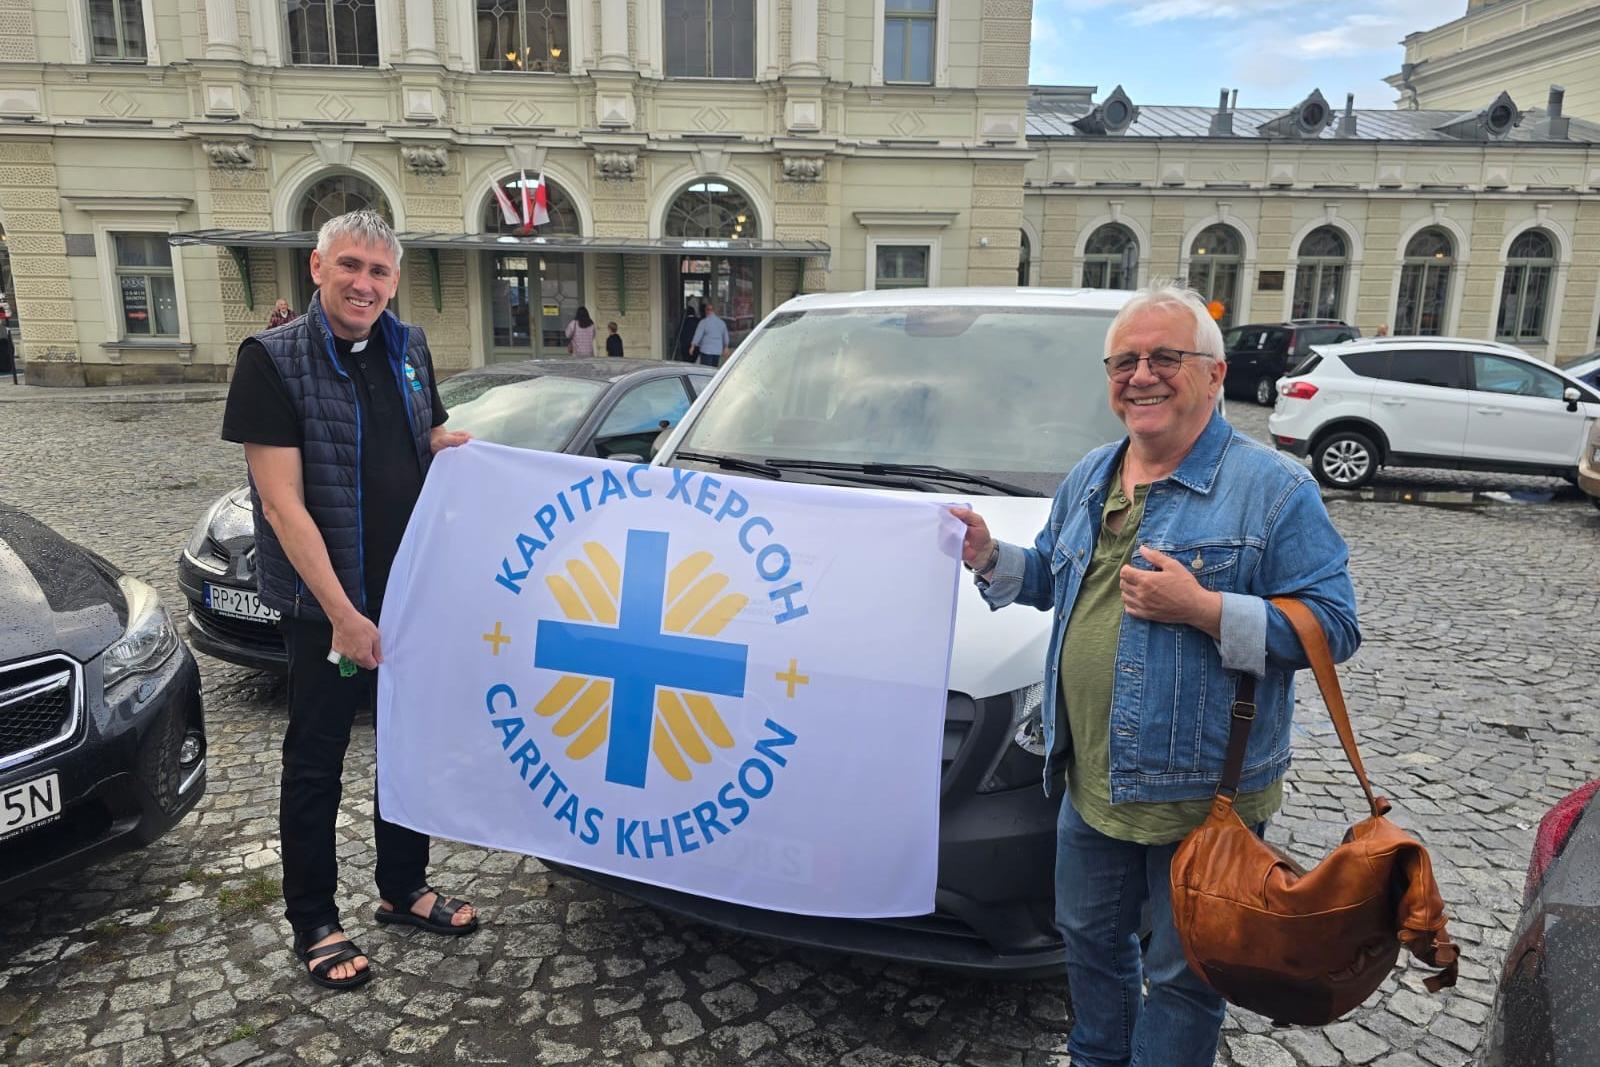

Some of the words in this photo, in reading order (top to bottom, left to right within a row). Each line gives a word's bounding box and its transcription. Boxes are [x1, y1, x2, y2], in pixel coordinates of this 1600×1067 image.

[495, 463, 652, 595] КАРІТАС
[666, 468, 809, 624] ХЕРСОН
[4, 779, 54, 826] 5N
[485, 683, 604, 846] CARITAS
[615, 718, 798, 860] KHERSON
